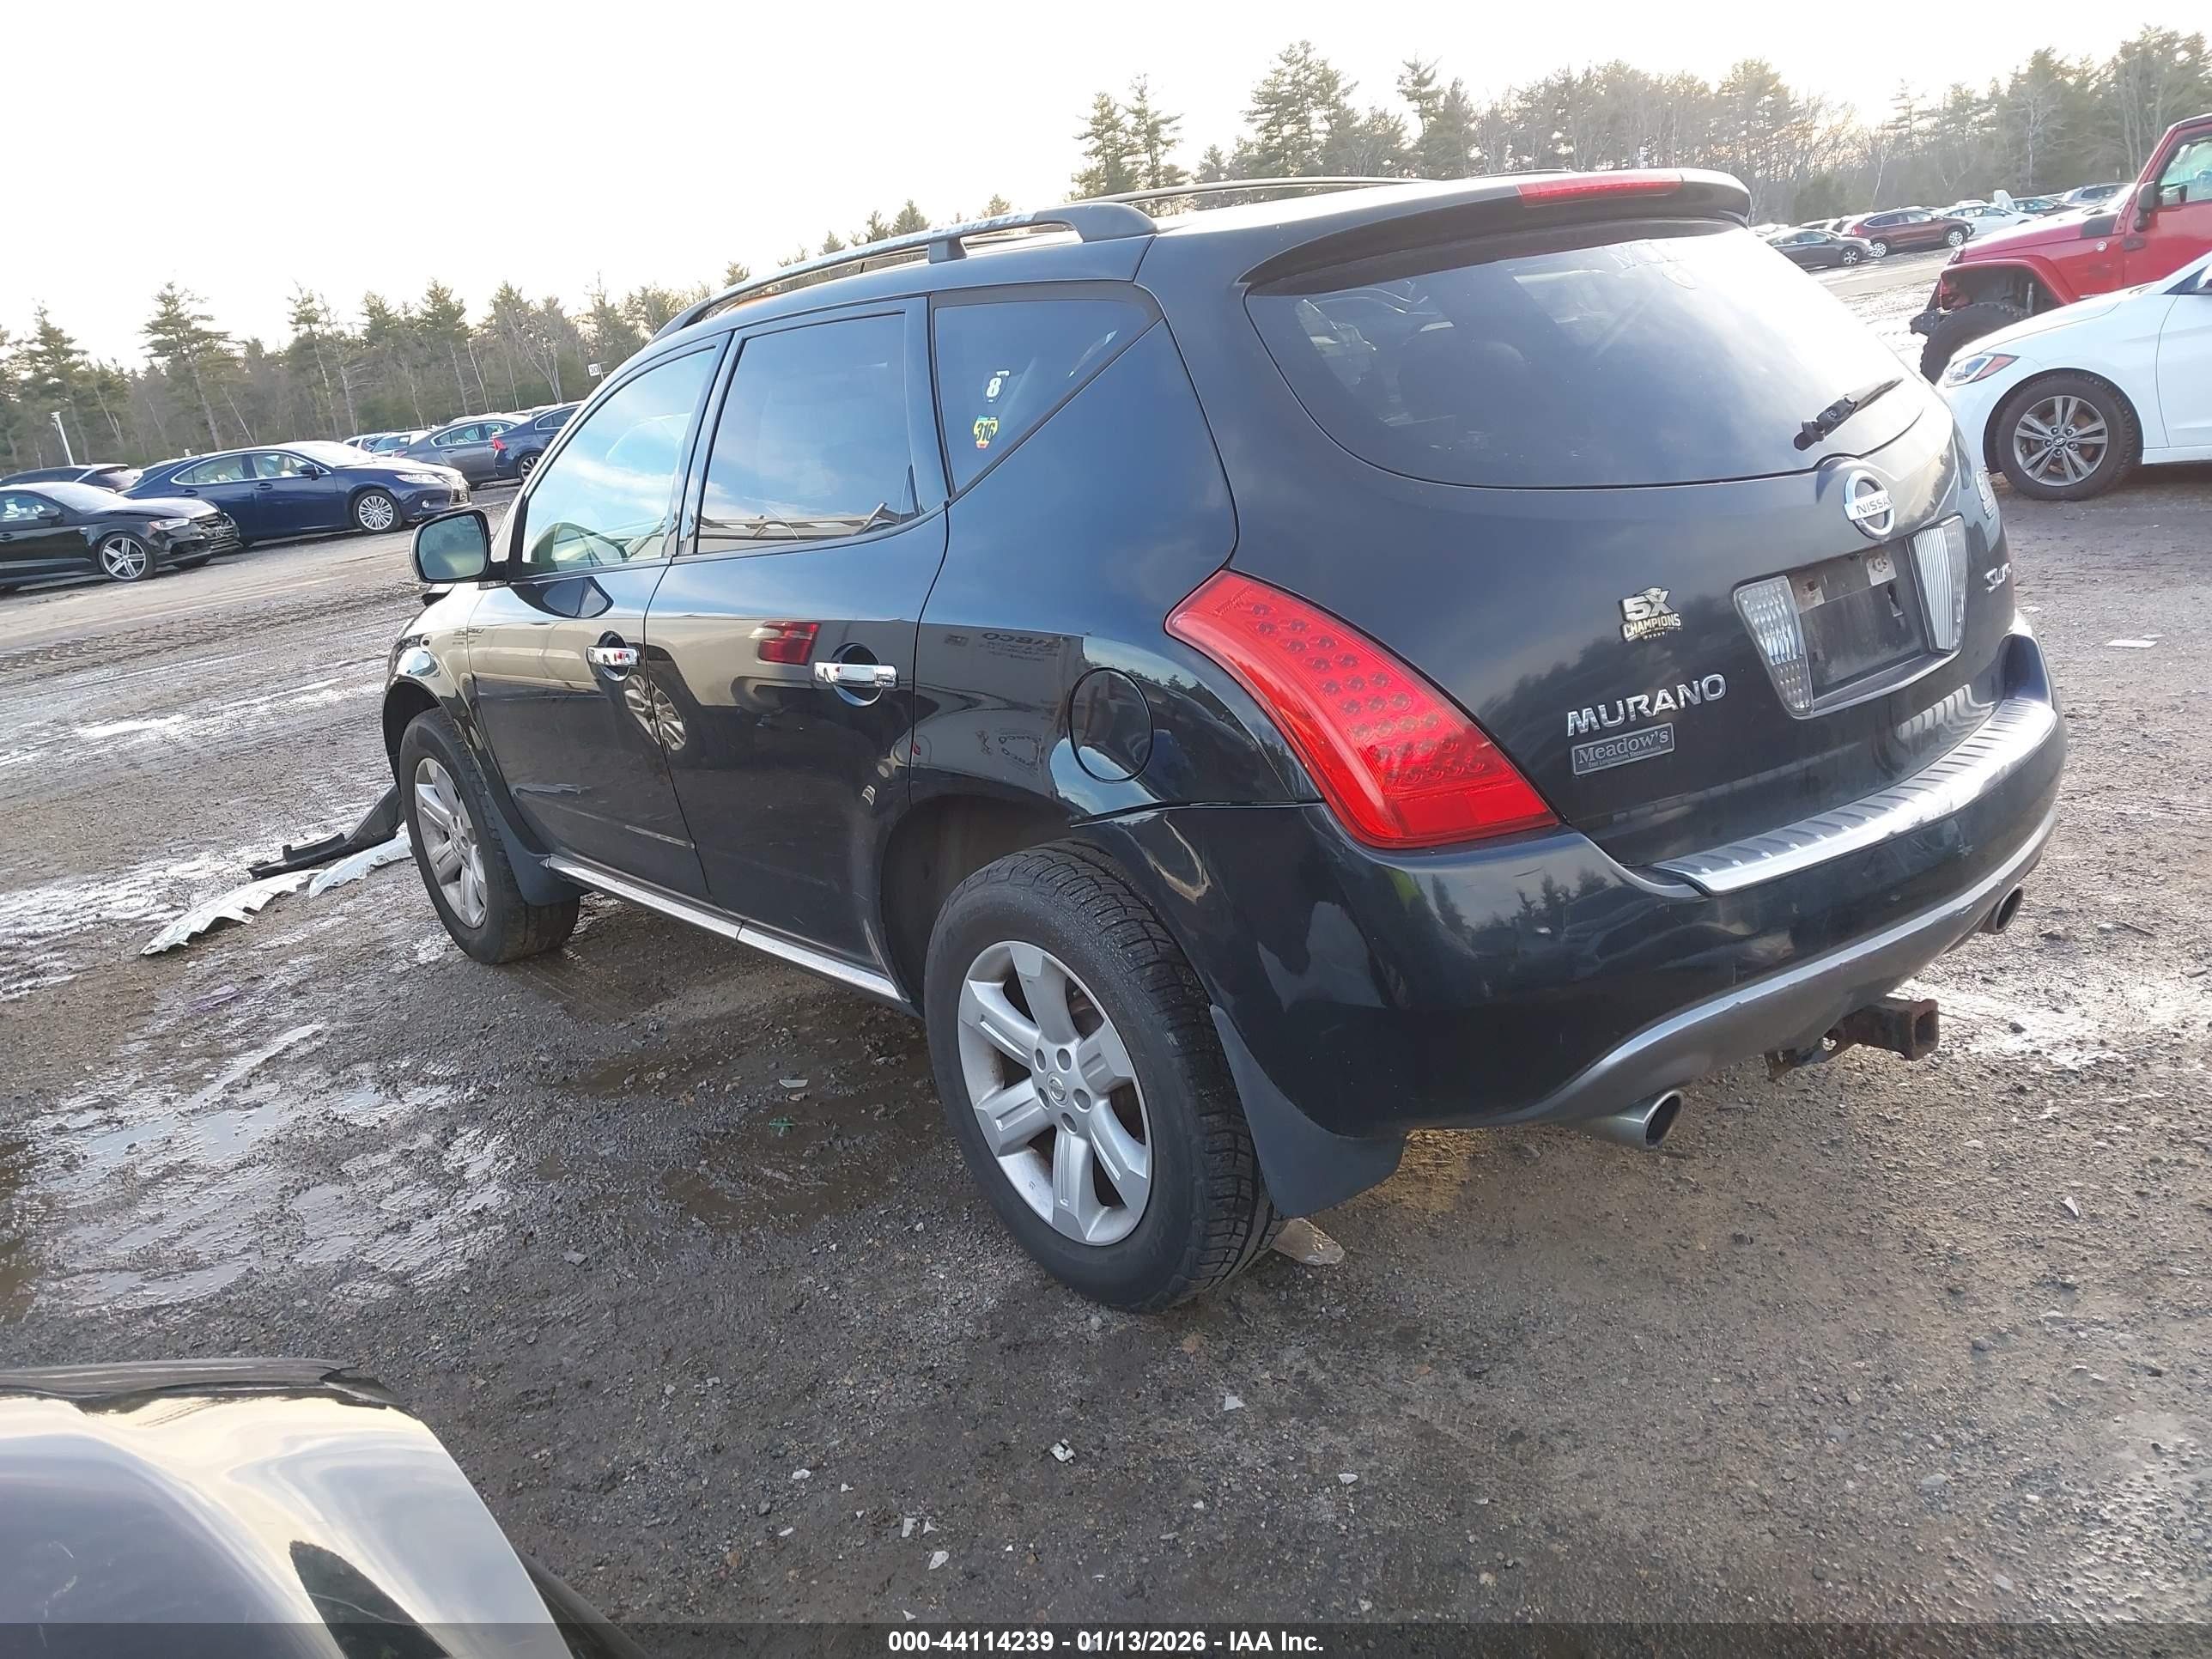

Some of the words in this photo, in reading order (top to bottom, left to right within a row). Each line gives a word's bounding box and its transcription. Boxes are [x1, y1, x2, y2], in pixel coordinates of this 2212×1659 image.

[1622, 613, 1682, 637] CHAMPIONS
[1567, 674, 1726, 736] MURANO
[1578, 730, 1668, 764] Meadow's
